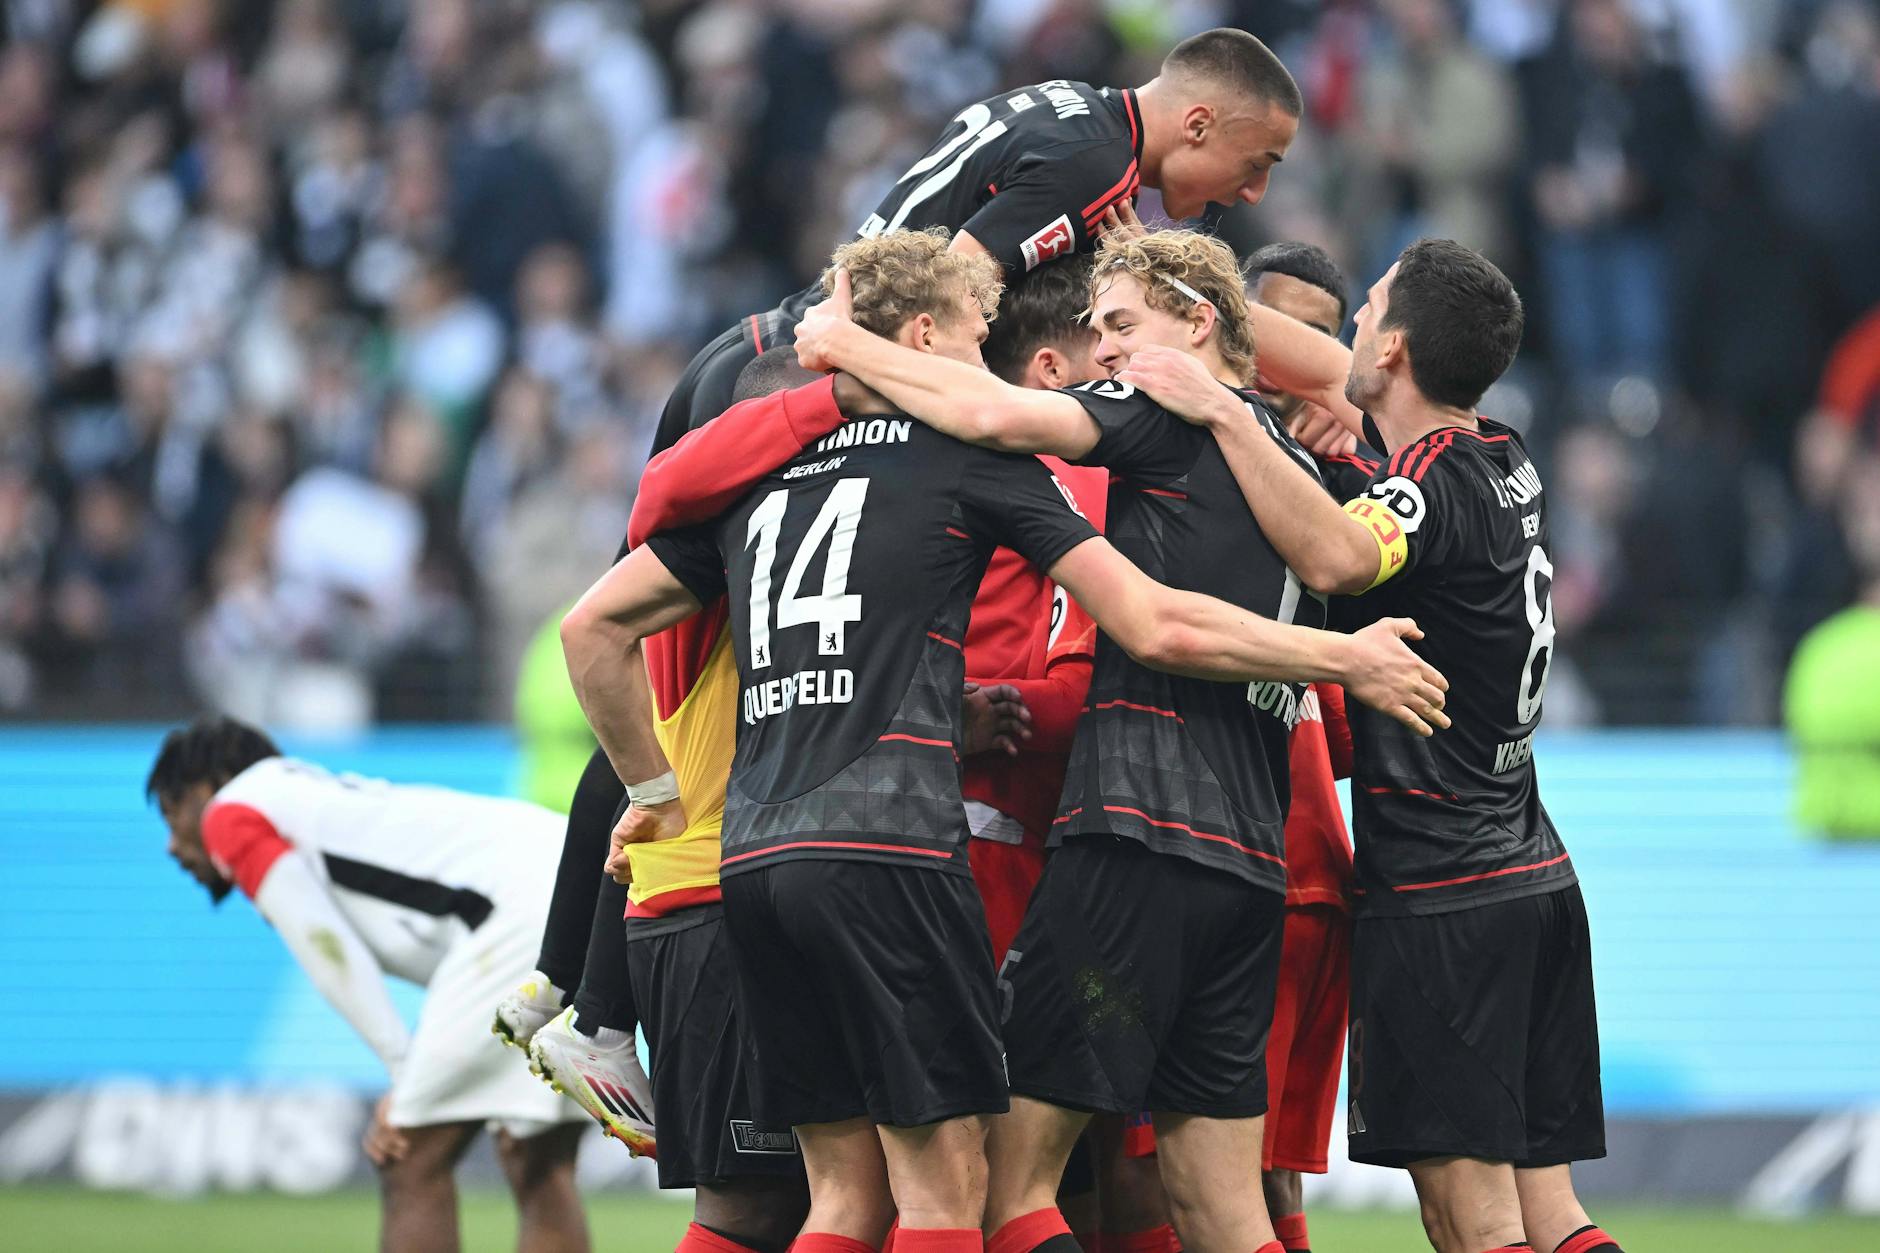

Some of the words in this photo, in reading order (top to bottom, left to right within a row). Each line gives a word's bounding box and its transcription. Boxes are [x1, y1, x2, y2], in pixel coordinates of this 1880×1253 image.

[744, 477, 870, 670] 14
[1517, 545, 1556, 725] 8
[744, 668, 854, 726] QUERFELD
